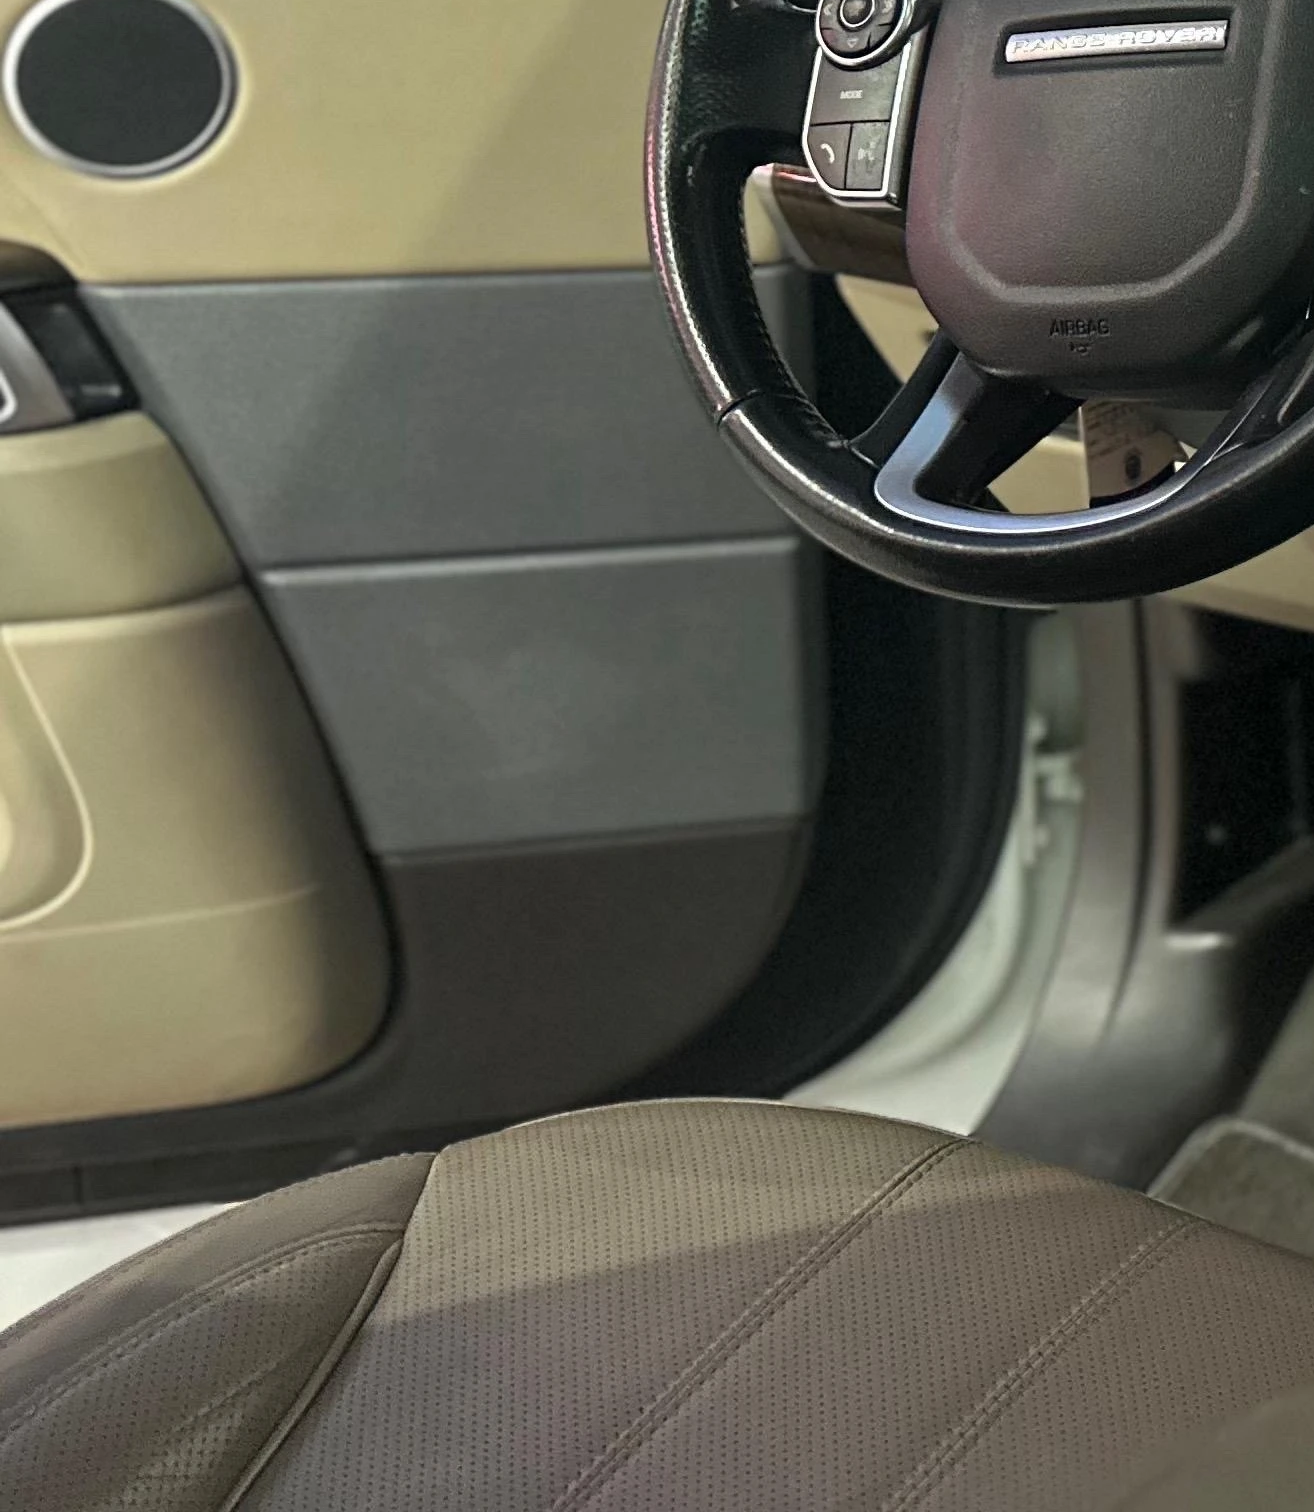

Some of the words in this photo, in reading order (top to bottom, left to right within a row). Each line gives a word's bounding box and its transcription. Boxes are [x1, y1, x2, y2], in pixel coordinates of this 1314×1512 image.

[1012, 30, 1107, 54] RANGE
[1118, 24, 1226, 47] ROVER
[1048, 318, 1111, 337] AIRBAG
